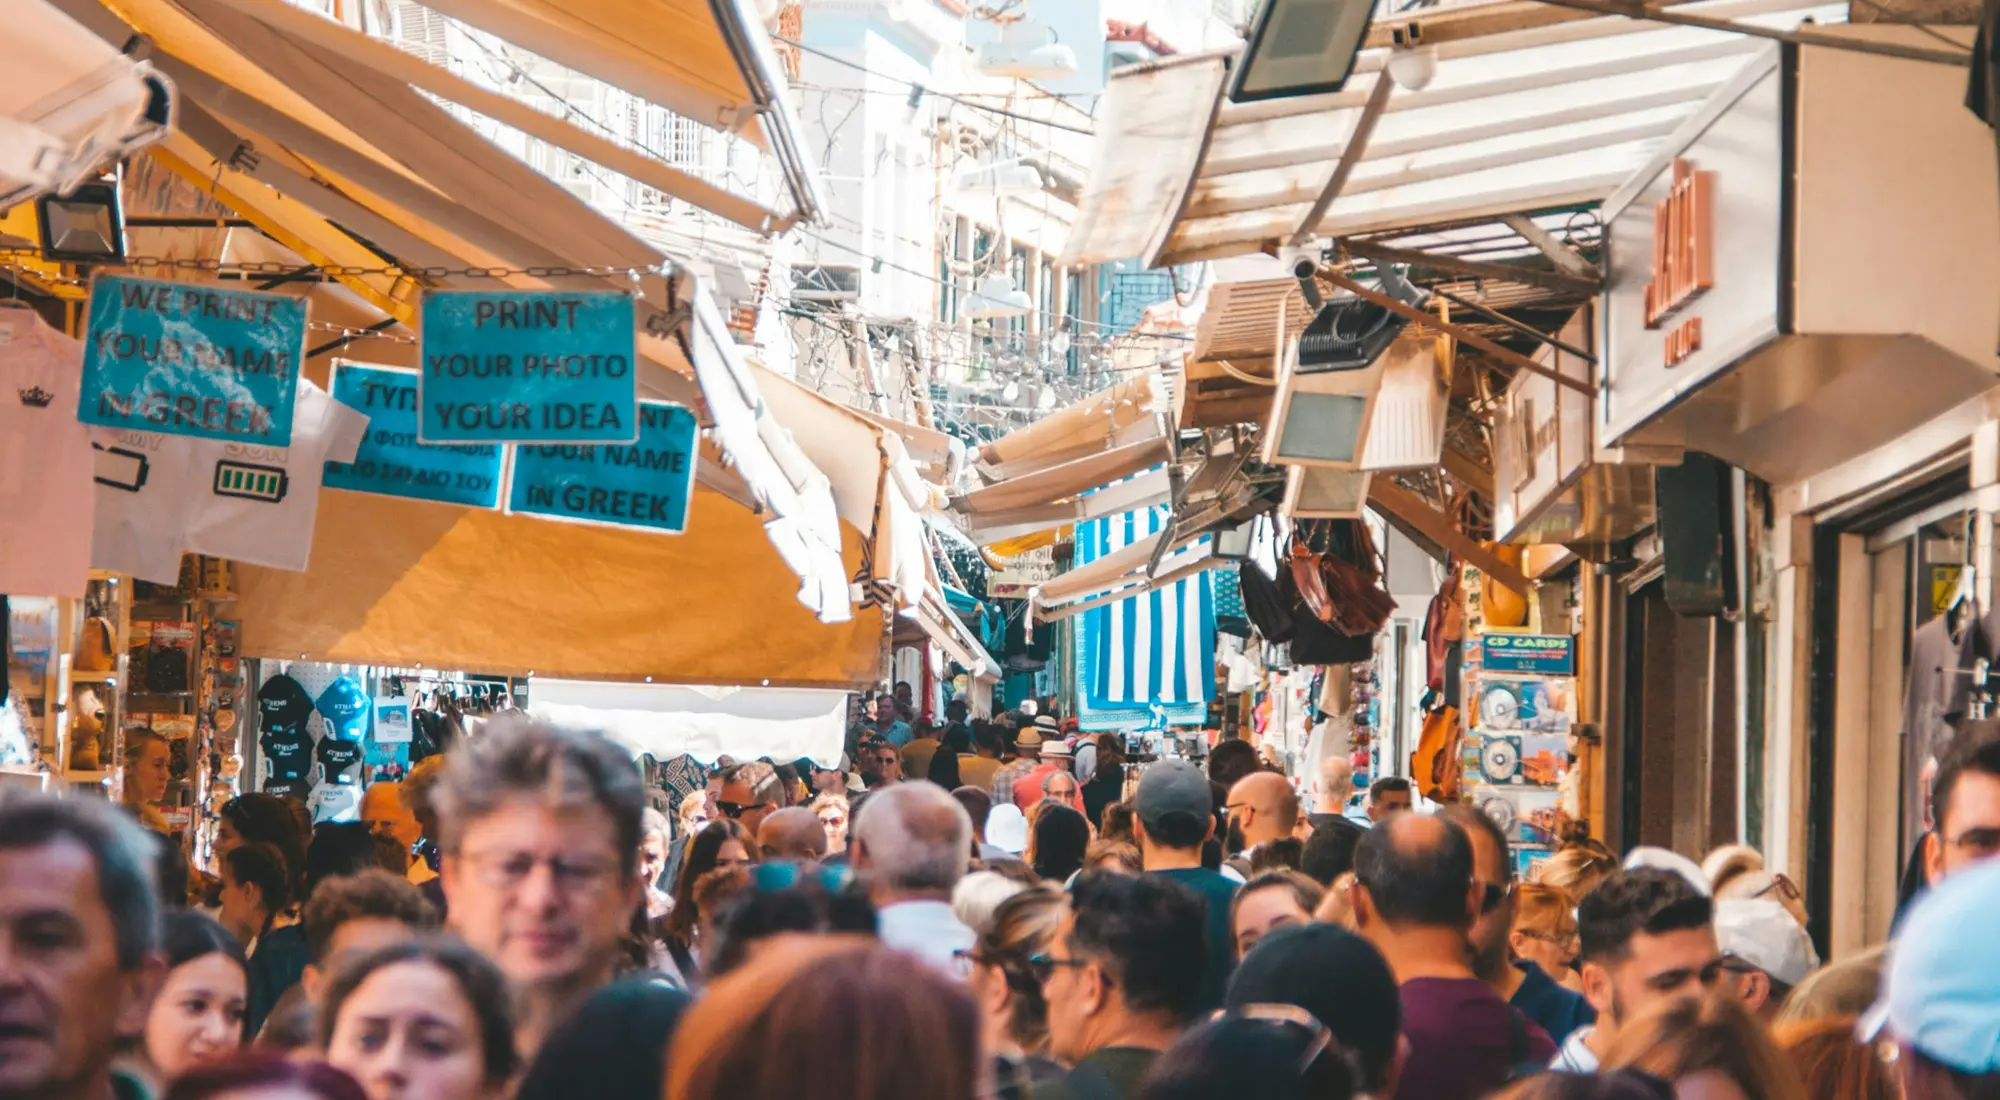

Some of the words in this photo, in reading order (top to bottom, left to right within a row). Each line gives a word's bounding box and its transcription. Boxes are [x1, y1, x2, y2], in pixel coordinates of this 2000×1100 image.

[121, 284, 172, 313] WE
[182, 290, 278, 326] PRINT
[476, 300, 582, 329] PRINT
[93, 329, 184, 366] YOUR
[193, 342, 292, 379] NAME
[429, 353, 513, 378] YOUR
[522, 354, 628, 378] PHOTO
[98, 392, 132, 418] IN
[143, 391, 274, 436] GREEK
[435, 403, 531, 430] YOUR
[541, 403, 621, 430] IDEA
[639, 407, 673, 429] NT
[524, 444, 595, 463] YOUR
[604, 446, 686, 473] NAME
[455, 473, 493, 491] ΣΟΥ
[526, 484, 554, 507] IN
[563, 483, 670, 521] GREEK
[1487, 637, 1509, 646] CD
[1513, 638, 1568, 648] CARDS
[273, 743, 299, 752] ATHENS
[326, 750, 354, 759] ATHENS
